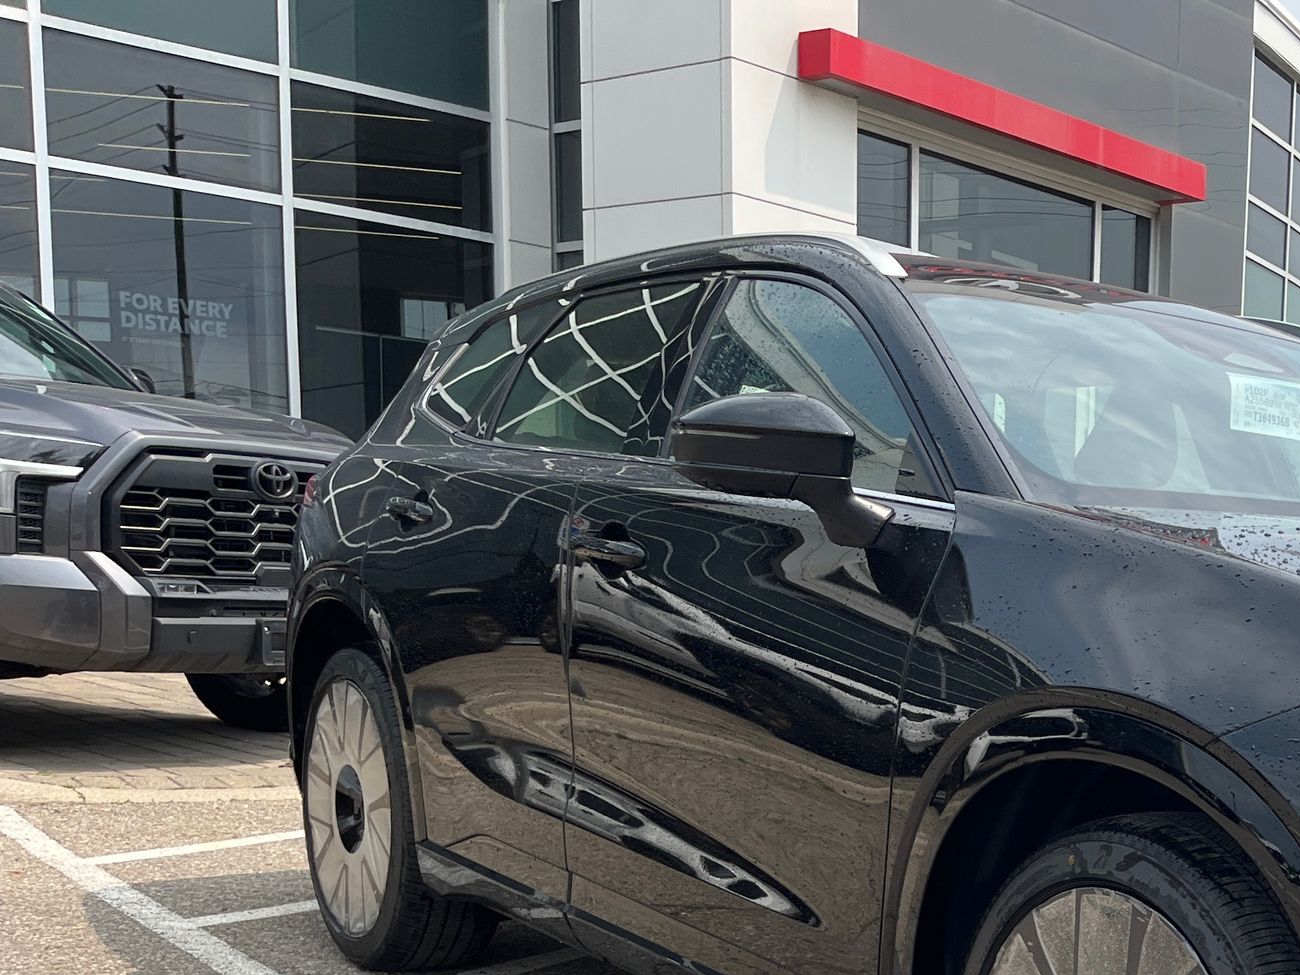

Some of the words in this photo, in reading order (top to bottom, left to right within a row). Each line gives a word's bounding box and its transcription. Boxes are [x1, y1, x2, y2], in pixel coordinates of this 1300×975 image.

[119, 291, 163, 313] FOR
[167, 297, 233, 320] EVERY
[121, 310, 228, 338] DISTANCE
